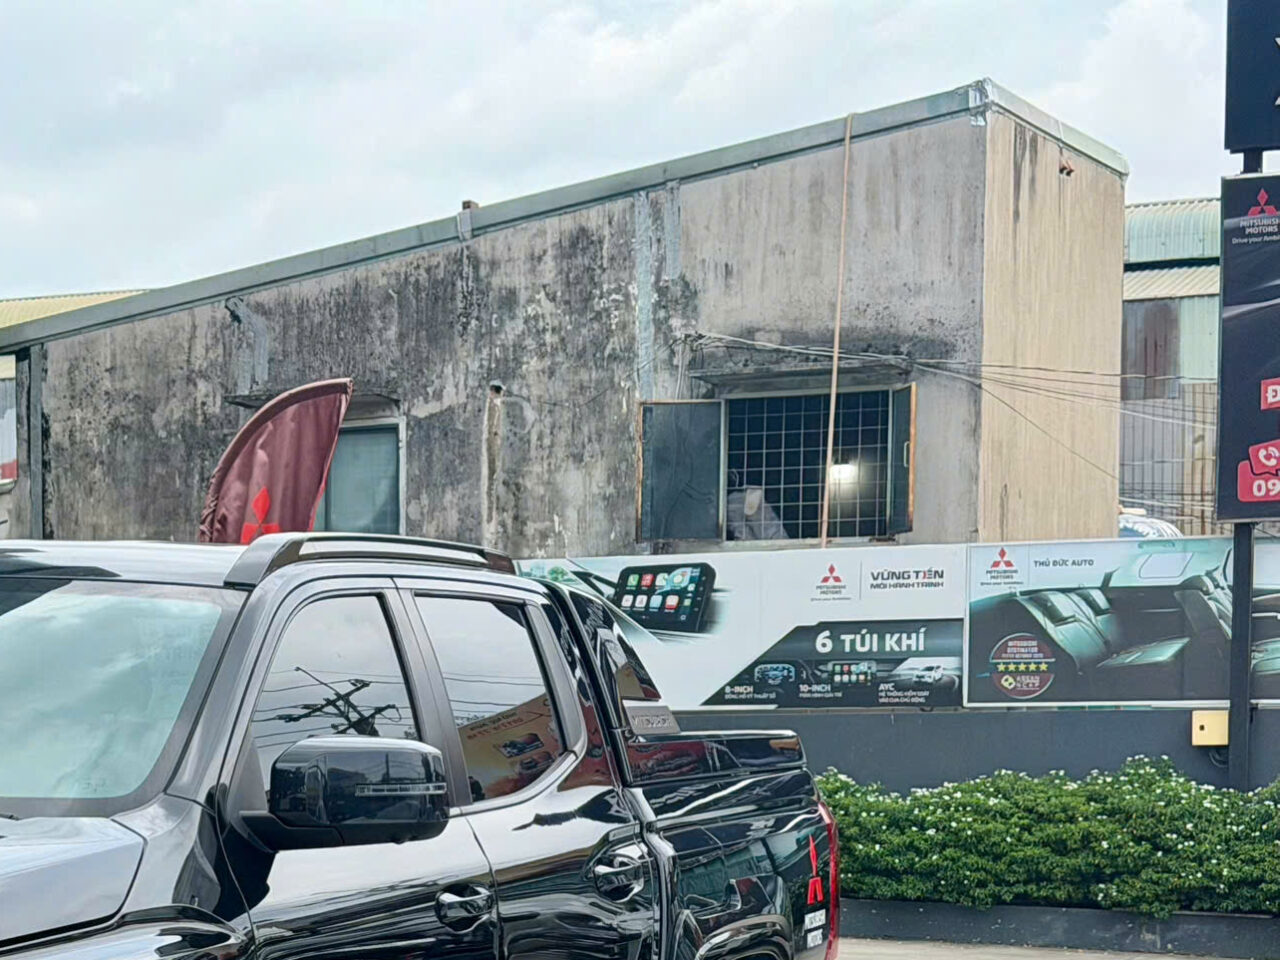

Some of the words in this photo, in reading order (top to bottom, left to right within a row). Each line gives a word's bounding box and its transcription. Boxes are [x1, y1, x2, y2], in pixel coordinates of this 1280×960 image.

[1033, 558, 1050, 568] THỦ
[1052, 558, 1069, 567] ĐỨC
[1071, 559, 1094, 567] AUTO
[870, 568, 911, 581] VỮNG
[815, 630, 833, 653] 6
[840, 628, 878, 653] TÚI
[885, 626, 927, 652] KHÍ
